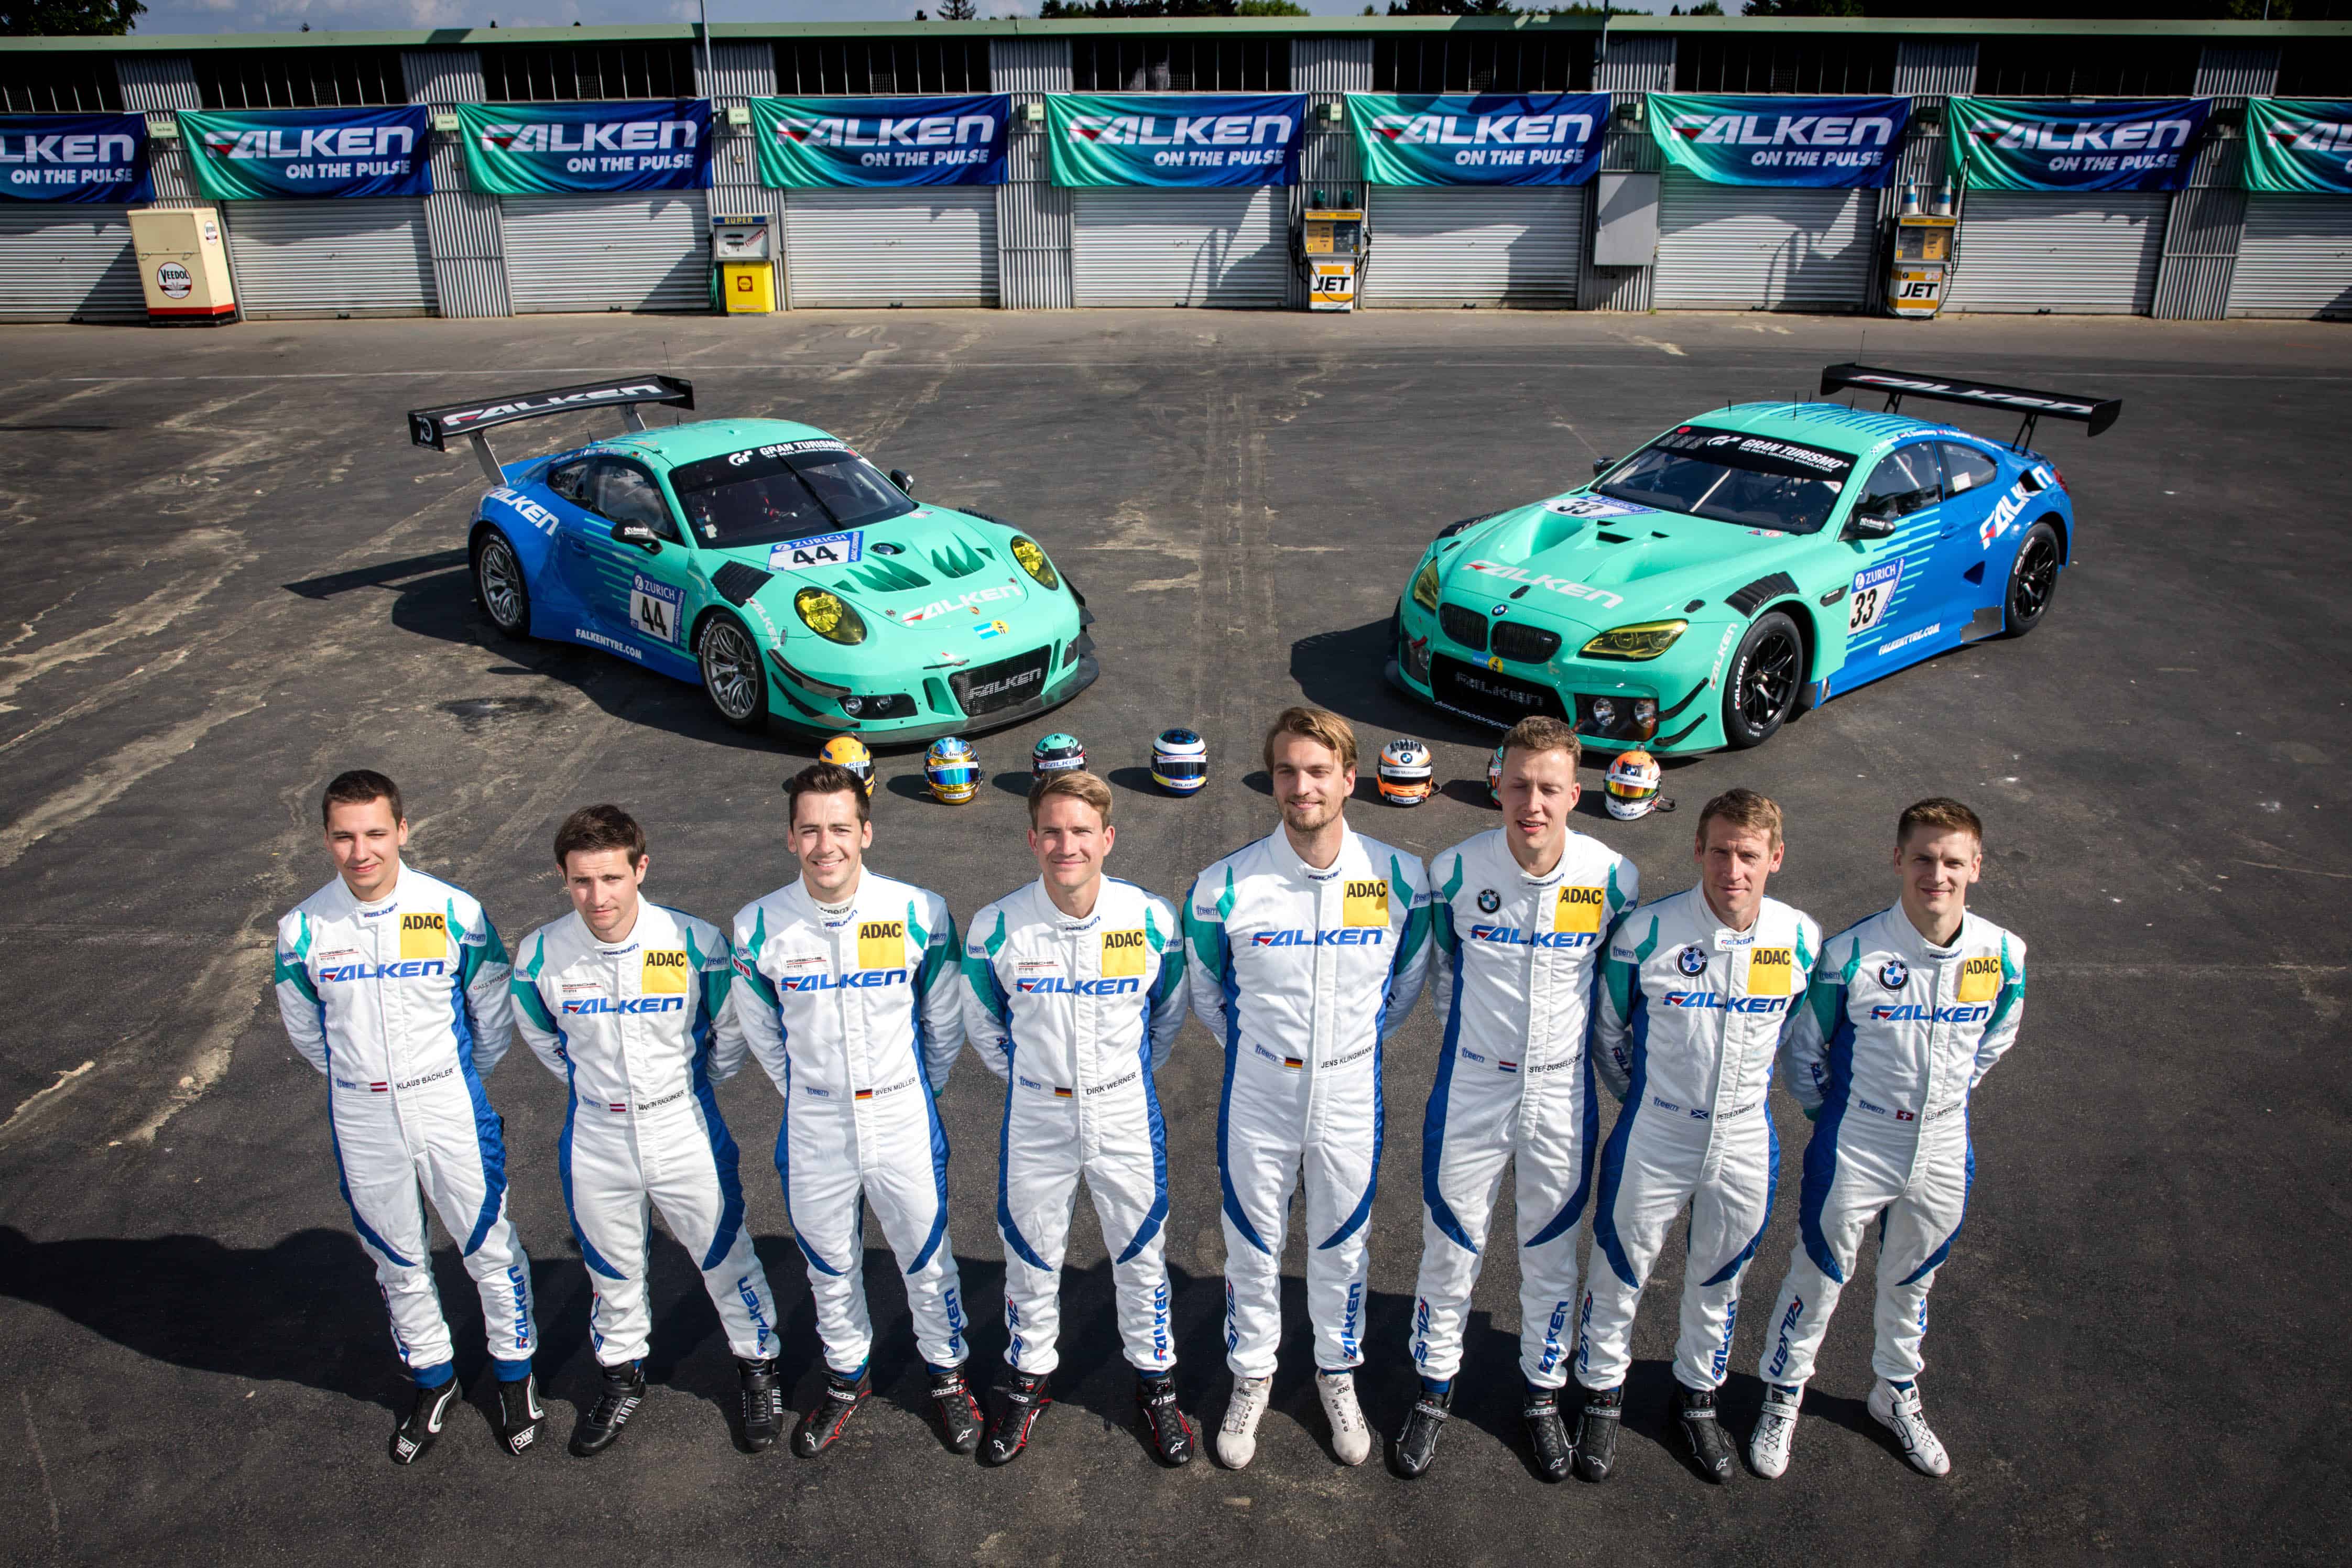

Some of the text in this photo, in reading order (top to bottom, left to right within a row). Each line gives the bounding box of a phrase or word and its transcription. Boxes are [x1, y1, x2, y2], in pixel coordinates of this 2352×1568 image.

[478, 121, 697, 152] FALKEN
[772, 115, 995, 147] FALKEN
[1064, 115, 1292, 145] FALKEN
[1365, 114, 1593, 144] FALKEN
[1667, 114, 1892, 145] FALKEN
[1964, 119, 2192, 151] FALKEN
[203, 126, 413, 158] FALKEN
[567, 154, 693, 172] ON THE PULSE
[861, 149, 989, 167] ON THE PULSE
[1154, 150, 1285, 166] ON THE PULSE
[1455, 149, 1584, 165] ON THE PULSE
[1751, 151, 1883, 166] ON THE PULSE
[2049, 154, 2180, 171] ON THE PULSE
[11, 168, 132, 183] ON THE PULSE
[287, 160, 410, 179] ON THE PULSE
[160, 269, 189, 284] VEEDOL
[1313, 276, 1351, 291] JET
[1899, 282, 1939, 298] JET
[1848, 375, 2093, 415] FALKEN
[442, 385, 663, 426] FALKEN
[759, 440, 845, 456] GRAN TURISMO
[1740, 439, 1844, 469] GRAN TURISMO
[1768, 451, 1794, 462] DRIVING
[1794, 458, 1833, 473] SIMULATOR
[1557, 500, 1604, 515] 33
[1599, 498, 1644, 511] ZURICH
[792, 533, 847, 548] ZURICH
[793, 546, 839, 565] 44
[1865, 564, 1897, 585] ZURICH
[645, 580, 676, 601] ZURICH
[1462, 559, 1624, 609] FALKEN
[900, 585, 1023, 626] FALKEN
[1851, 588, 1878, 629] 33
[641, 596, 668, 637] 44
[745, 597, 781, 650] FALKEN
[576, 628, 642, 660] FALKENTYRE.COM
[699, 617, 715, 656] FALKEN
[1878, 623, 1940, 656] FALKENTYRE.COM
[1709, 623, 1738, 690] FALKEN
[967, 667, 1042, 700] FALKEN
[1734, 656, 1748, 710] FALKEN
[929, 762, 978, 772] PORSCHE
[1043, 758, 1081, 768] FALKEN
[1346, 881, 1386, 898] ADAC
[1560, 888, 1602, 905] ADAC
[364, 902, 398, 918] FALKEN
[825, 909, 858, 927] FALKEN
[1196, 905, 1218, 916] freem
[402, 916, 443, 930] ADAC
[860, 923, 902, 939] ADAC
[1065, 916, 1101, 931] FALKEN
[1105, 931, 1143, 949] ADAC
[1248, 929, 1383, 947] FALKEN
[1468, 924, 1597, 948] FALKEN
[1721, 936, 1755, 945] FALKEN
[603, 943, 639, 955] FALKEN
[1613, 946, 1635, 958] freem
[1752, 950, 1791, 965] ADAC
[1929, 949, 1963, 959] FALKEN
[646, 952, 684, 966] ADAC
[707, 956, 728, 965] freem
[1966, 959, 1998, 975] ADAC
[317, 961, 444, 983] FALKEN
[777, 970, 907, 992] FALKEN
[1819, 971, 1840, 979] freem
[1013, 977, 1139, 995] FALKEN
[559, 997, 684, 1015] FALKEN
[1661, 991, 1788, 1013] FALKEN
[1867, 1005, 1989, 1022] FALKEN
[1321, 1044, 1373, 1069] JENS KLINGMANN
[1462, 1047, 1485, 1063] freem
[1528, 1064, 1545, 1074] STEF
[397, 1068, 453, 1090] KLAUS BACHLER
[875, 1077, 916, 1096] SVEN MÜLLER
[1086, 1072, 1136, 1095] DIRK WERNER
[638, 1090, 684, 1111] MARTIN RAGGINGER
[1653, 1097, 1679, 1112] freem
[1716, 1110, 1733, 1120] PETER
[507, 1265, 529, 1353] FALKEN
[737, 1275, 770, 1356] FALKEN
[1153, 1282, 1168, 1365] FALKEN
[1711, 1300, 1736, 1381] FALKEN
[1768, 1293, 1804, 1377] FALKEN
[1237, 1387, 1251, 1397] JENS
[1336, 1384, 1351, 1395] JENS
